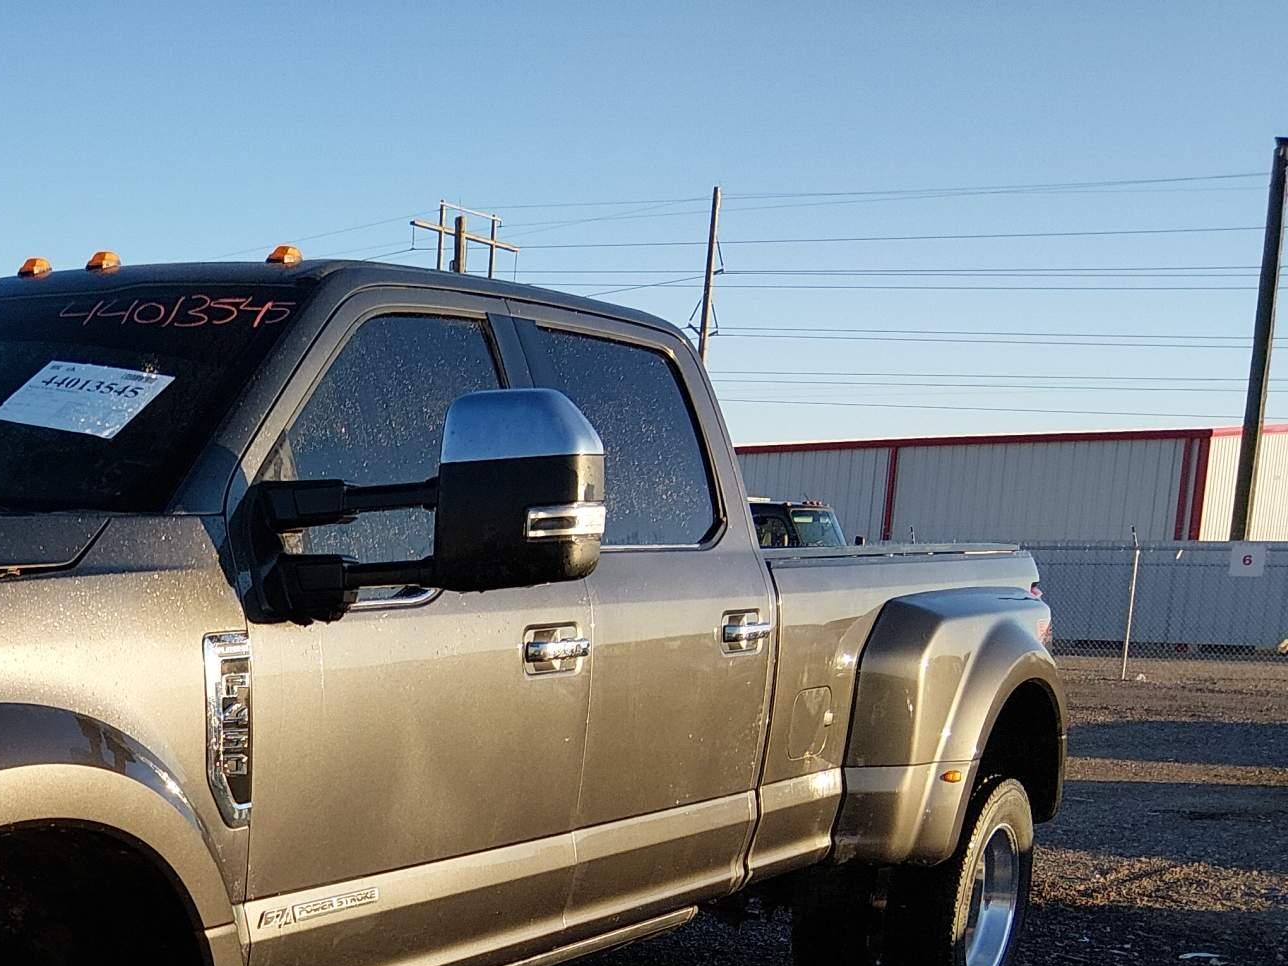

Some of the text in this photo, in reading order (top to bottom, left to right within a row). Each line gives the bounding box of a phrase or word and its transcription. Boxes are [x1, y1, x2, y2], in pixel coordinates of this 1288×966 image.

[60, 295, 297, 328] 44013545
[41, 375, 144, 399] 44013545
[1242, 554, 1253, 566] 6
[297, 901, 334, 917] POWER
[336, 888, 377, 908] STROKE
